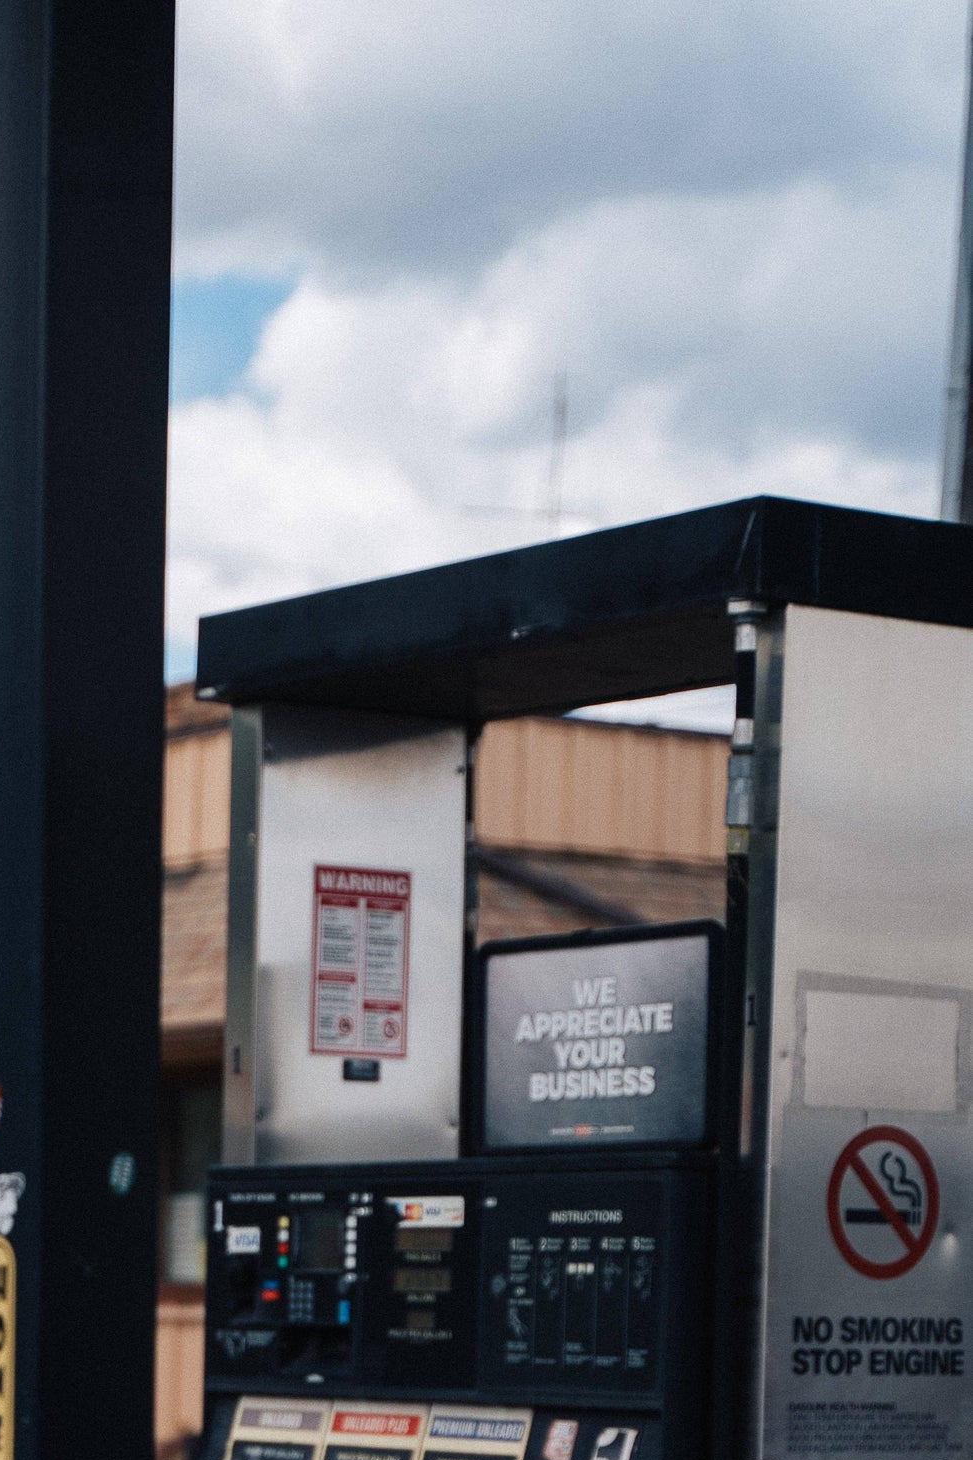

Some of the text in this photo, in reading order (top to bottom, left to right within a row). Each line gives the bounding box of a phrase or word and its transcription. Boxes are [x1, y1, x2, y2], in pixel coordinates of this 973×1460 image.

[319, 871, 408, 896] WARNING
[573, 976, 617, 1006] WE
[514, 1002, 673, 1043] APPRECIATE
[553, 1037, 626, 1070] YOUR
[529, 1066, 656, 1102] BUSINESS
[550, 1210, 623, 1223] INSTRUCTIONS
[234, 1234, 259, 1247] VISA
[793, 1316, 963, 1344] NO SMOKING
[792, 1349, 965, 1376] STOP ENGINE
[343, 1415, 410, 1434] UNLEADED PLUS
[432, 1420, 525, 1440] PREMIUM UNLEADED
